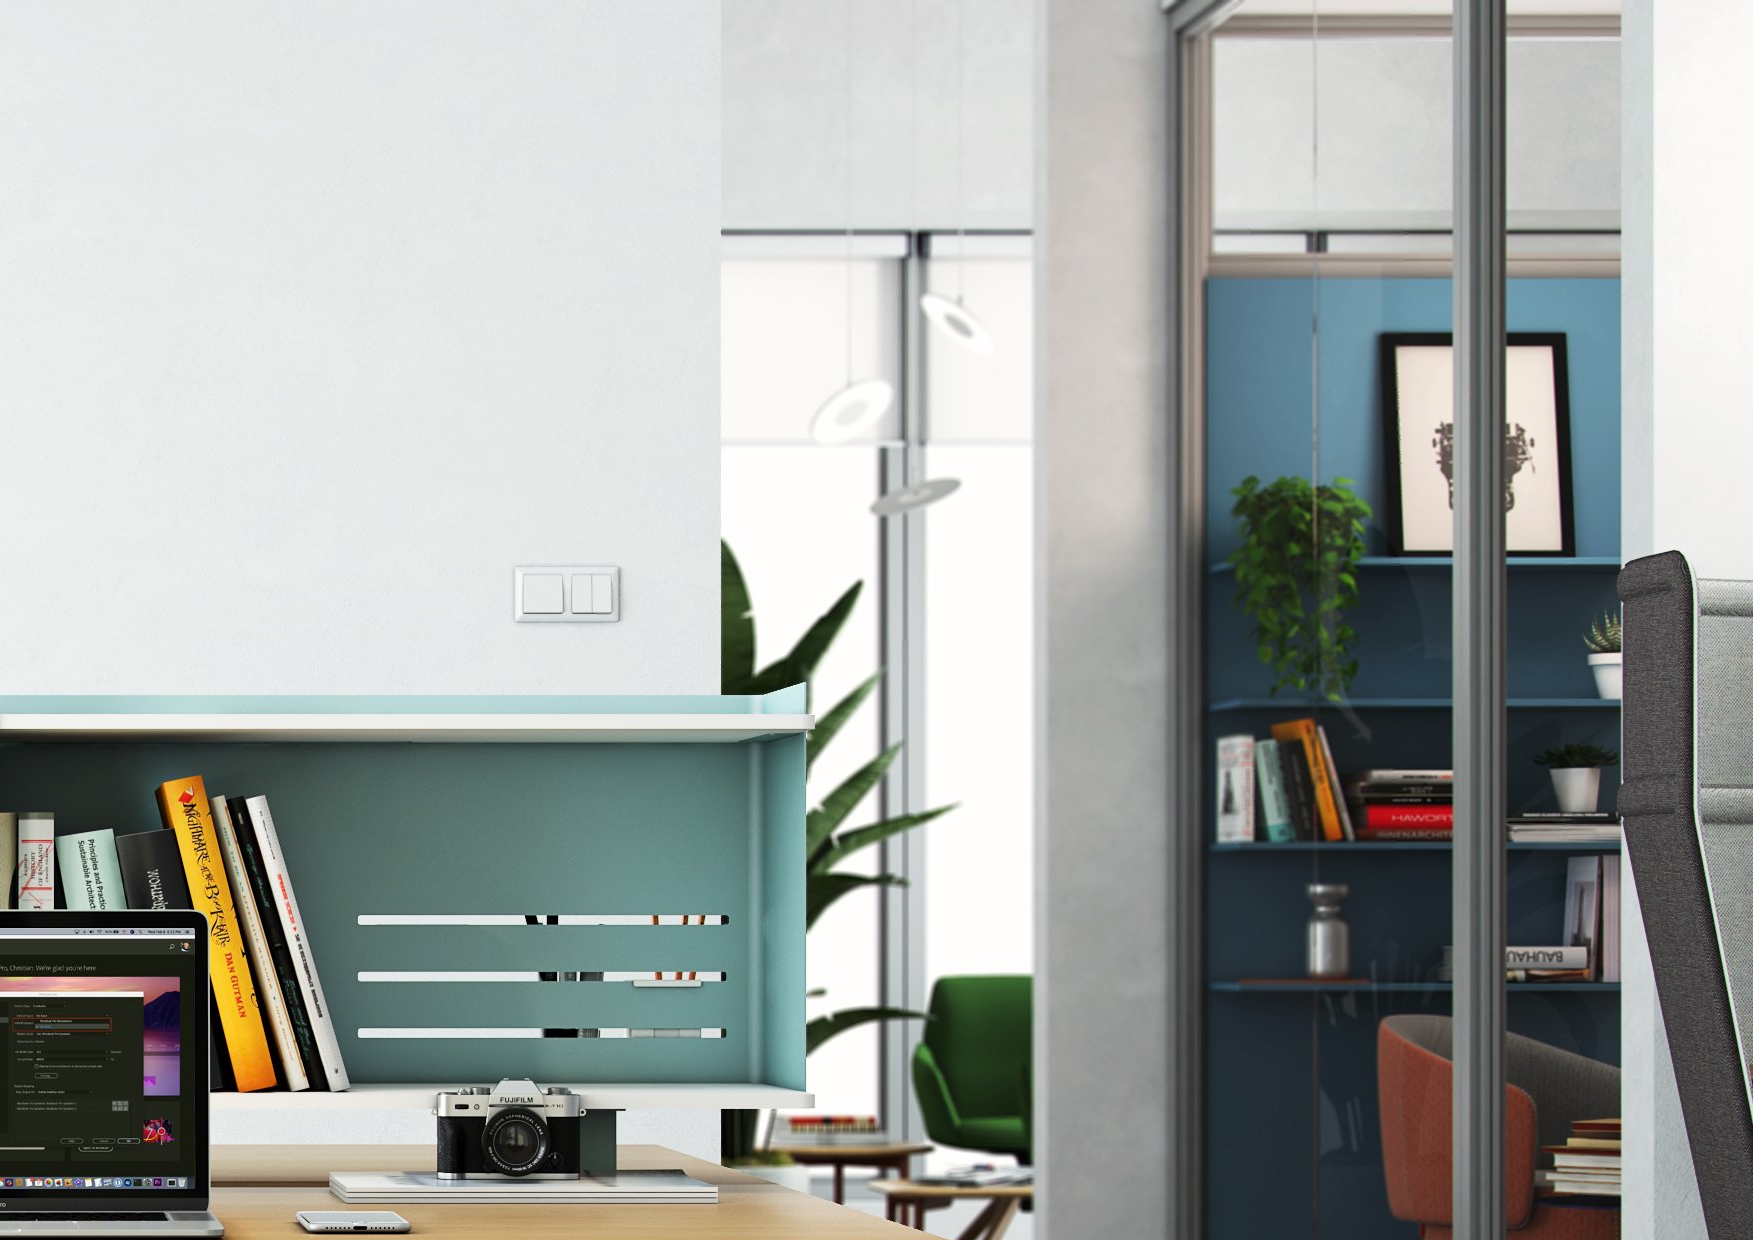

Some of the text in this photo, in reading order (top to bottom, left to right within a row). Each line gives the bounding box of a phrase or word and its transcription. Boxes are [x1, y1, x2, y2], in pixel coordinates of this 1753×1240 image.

[181, 800, 214, 868] NIGHTMARE
[78, 841, 90, 879] Sustainable
[88, 839, 98, 870] Principles
[94, 872, 102, 885] and
[39, 878, 43, 886] OF
[52, 964, 64, 973] glad
[66, 964, 82, 973] you're
[223, 951, 250, 1019] DAN GUTMAN
